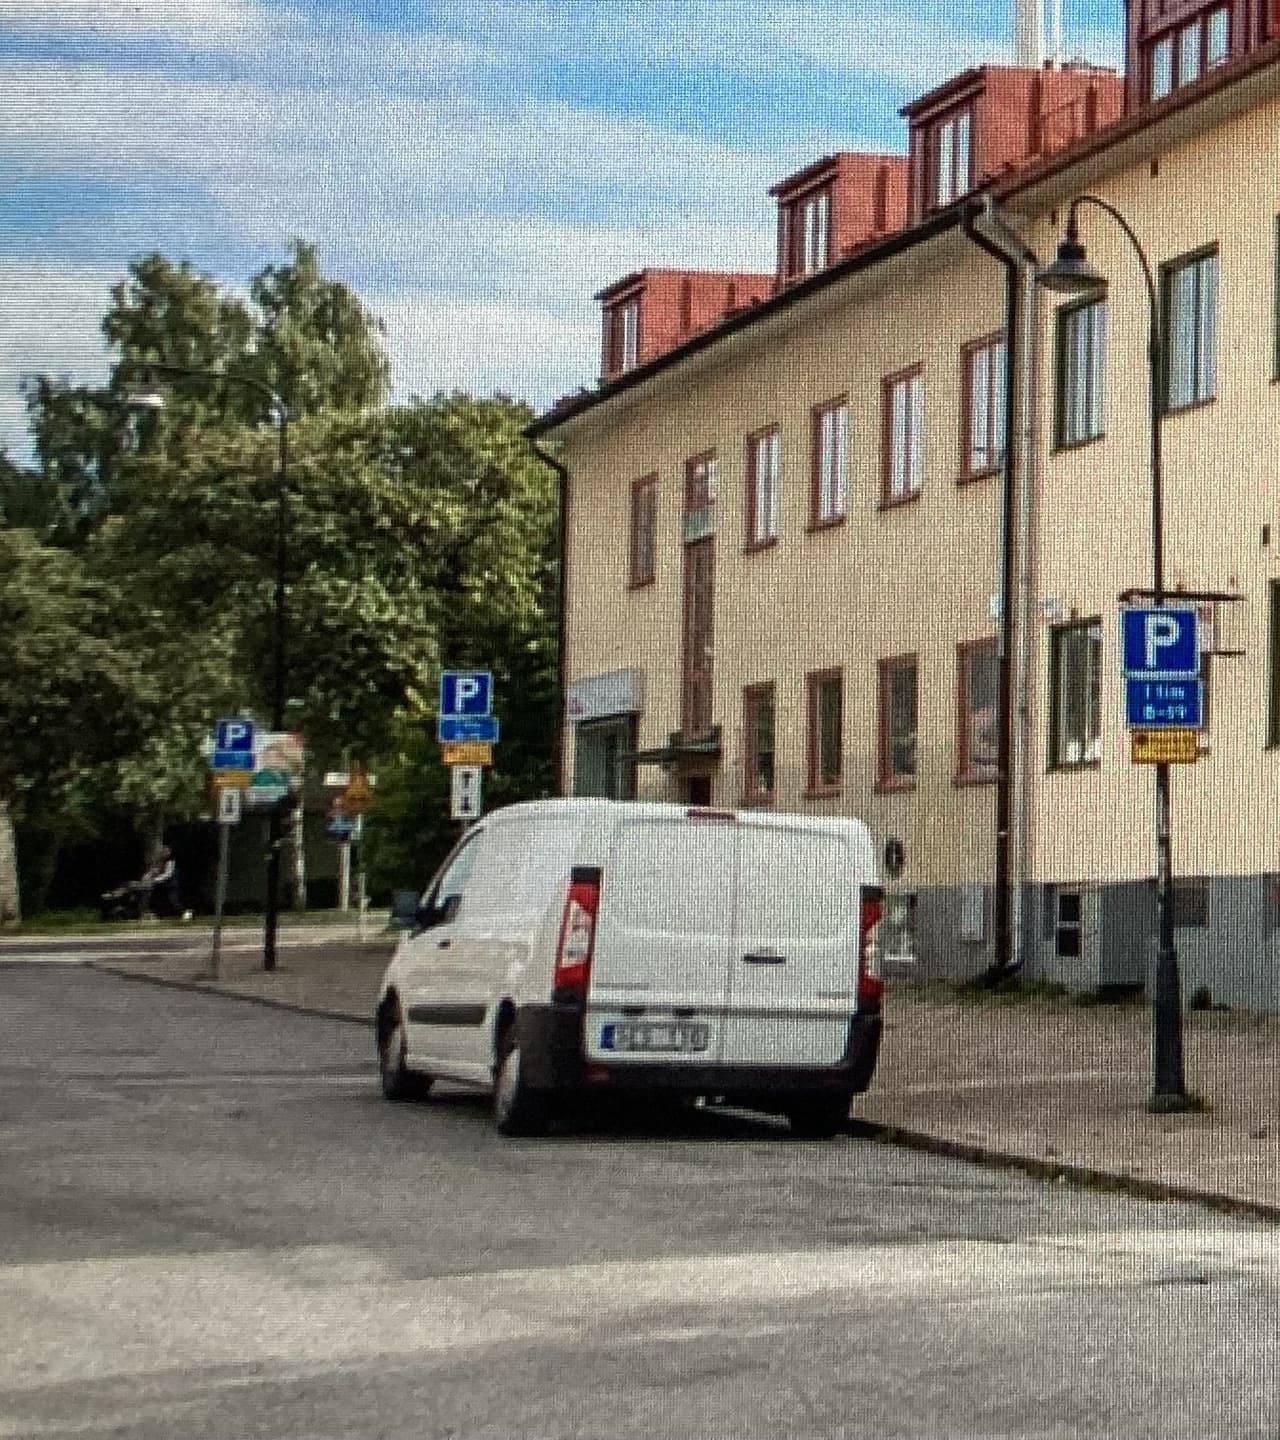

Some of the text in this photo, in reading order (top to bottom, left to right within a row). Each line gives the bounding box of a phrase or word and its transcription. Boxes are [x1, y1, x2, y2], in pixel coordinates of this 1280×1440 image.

[1144, 614, 1180, 667] P
[455, 678, 479, 712] P
[225, 725, 247, 748] P
